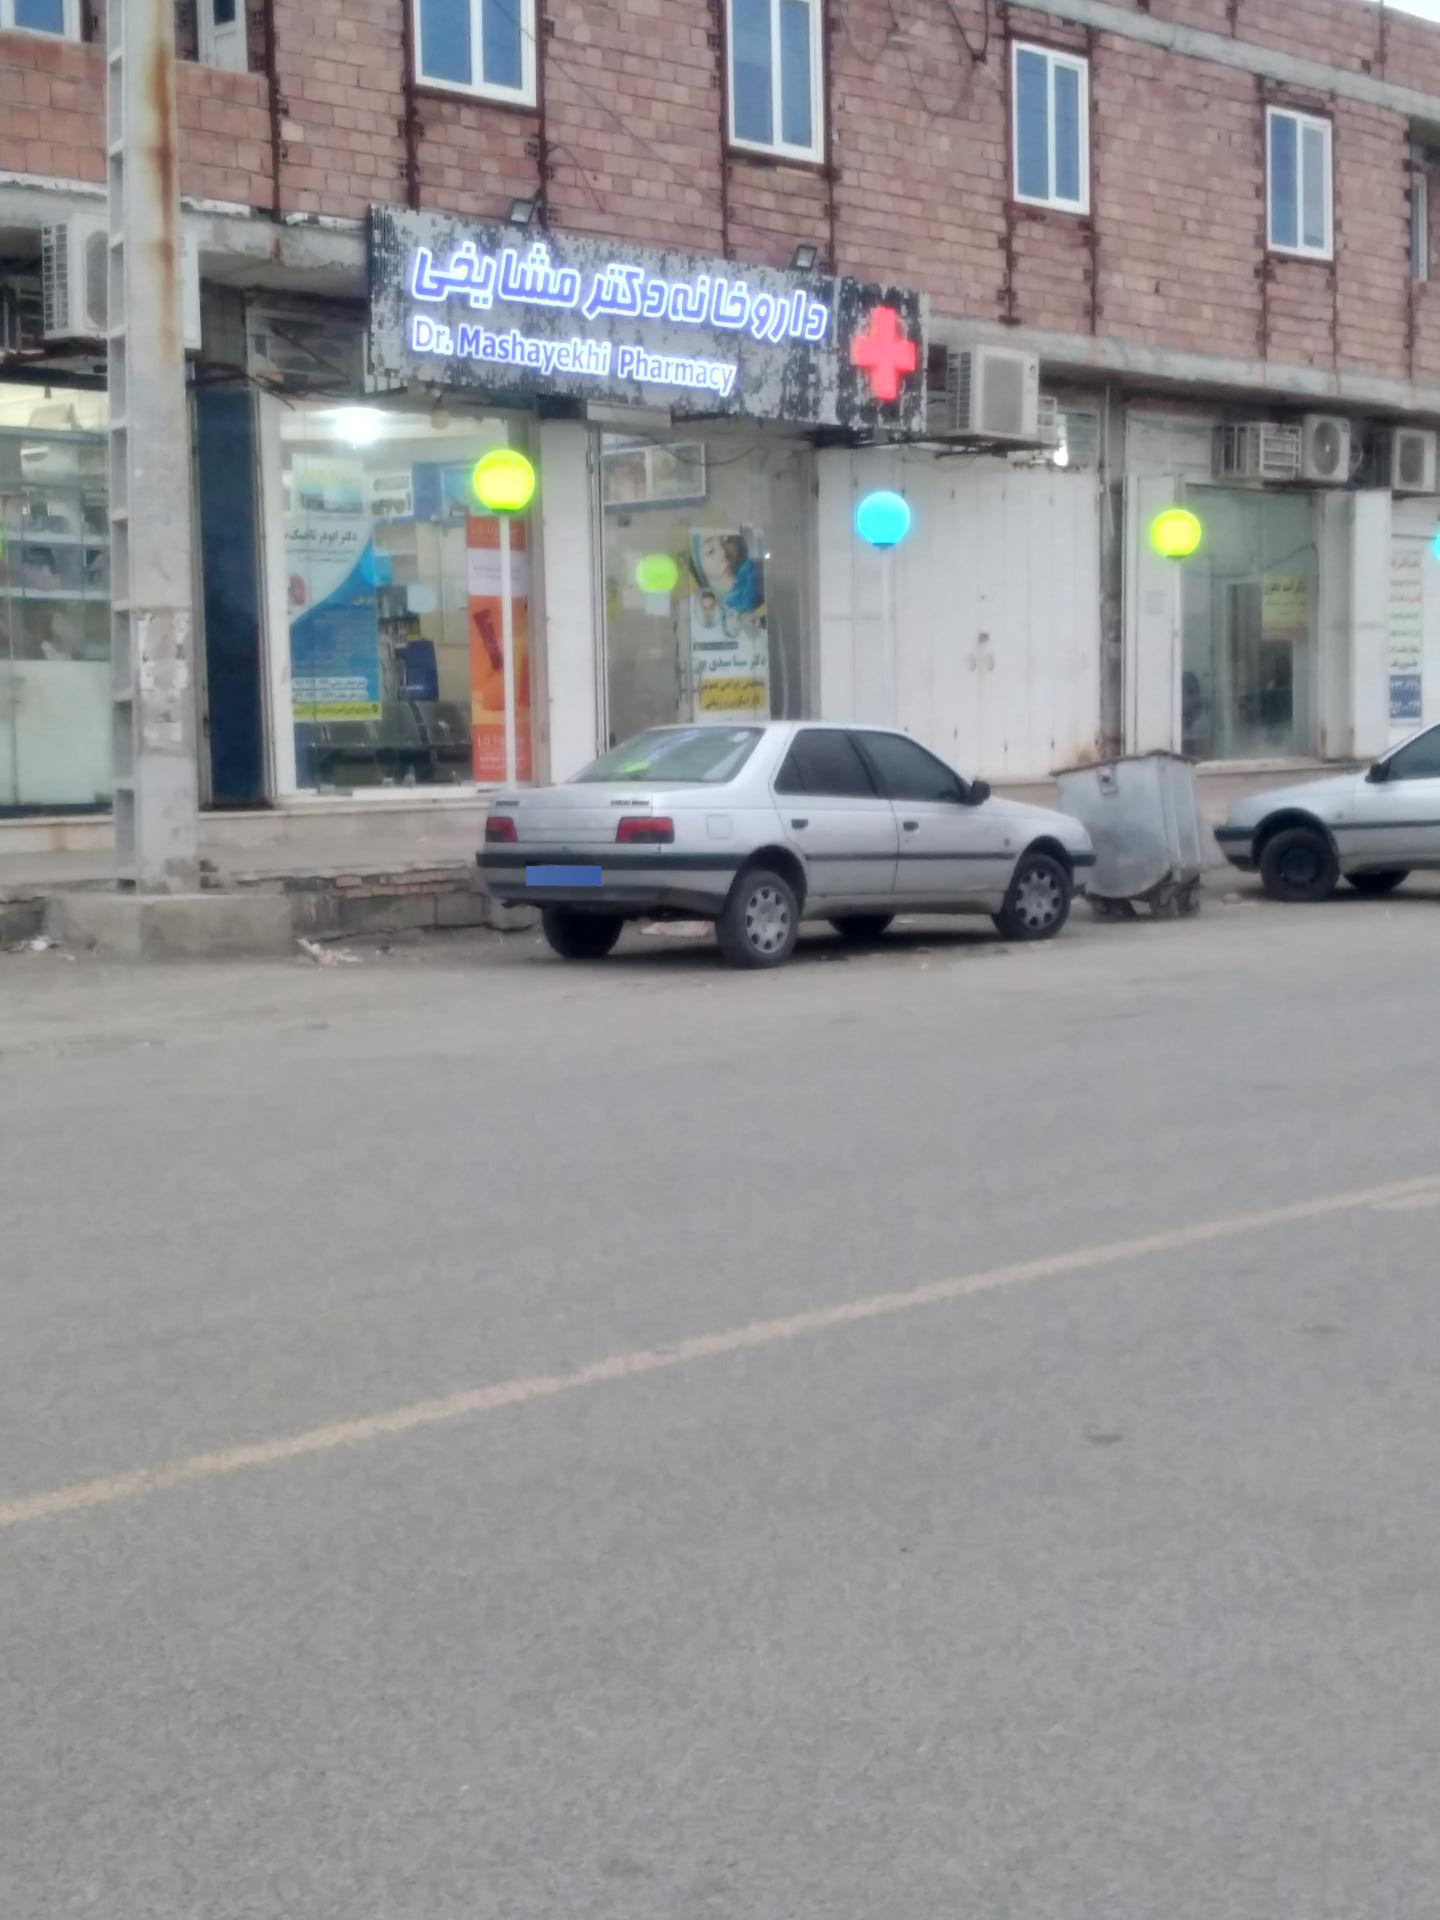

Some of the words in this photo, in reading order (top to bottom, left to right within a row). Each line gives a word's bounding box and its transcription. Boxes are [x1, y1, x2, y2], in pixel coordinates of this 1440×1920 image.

[412, 241, 581, 309] مشایخی
[583, 263, 668, 320] دکتر
[668, 275, 828, 343] داروخانه
[412, 315, 453, 355] Dr.
[457, 323, 611, 375] Mashayekhi
[617, 345, 736, 397] Pharmacy
